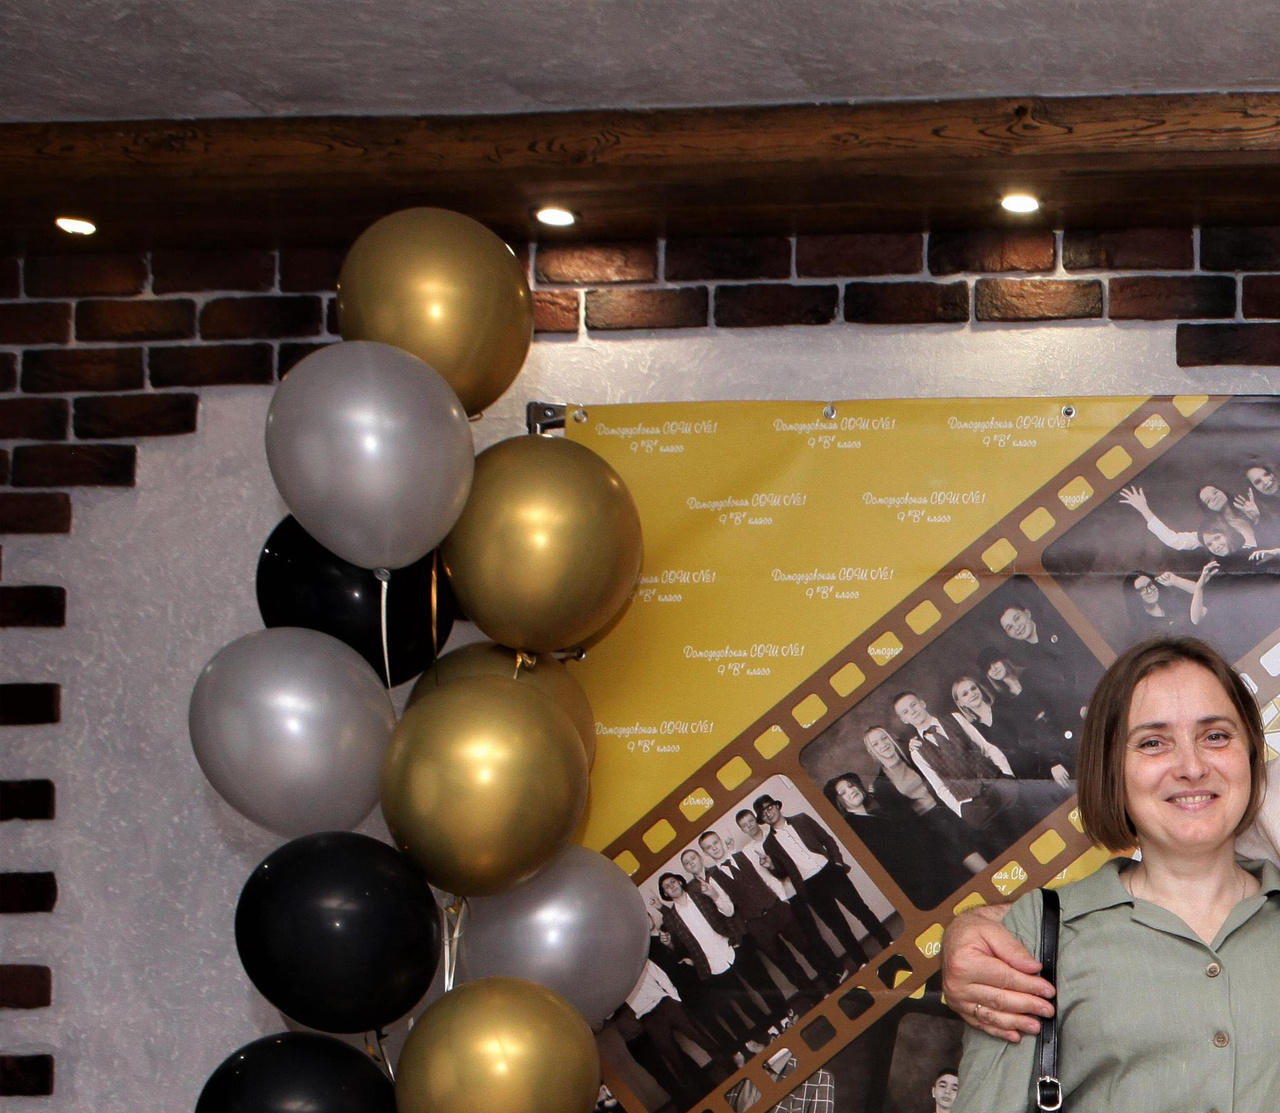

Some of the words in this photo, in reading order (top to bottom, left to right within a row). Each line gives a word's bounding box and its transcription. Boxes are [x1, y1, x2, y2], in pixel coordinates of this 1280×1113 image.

[662, 421, 692, 435] СОШ
[840, 417, 869, 431] СОШ
[1016, 415, 1044, 429] СОШ
[630, 441, 638, 453] 9
[807, 437, 816, 449] 9
[982, 436, 991, 448] 9
[751, 494, 780, 508] СОШ
[930, 491, 959, 505] СОШ
[719, 514, 727, 525] 9
[897, 512, 905, 523] 9
[661, 570, 690, 585] СОШ
[838, 567, 868, 582] СОШ
[806, 588, 814, 600] 9
[750, 644, 779, 659] СОШ
[717, 665, 726, 677] 9
[659, 721, 689, 735] СОШ
[627, 741, 635, 753] 9
